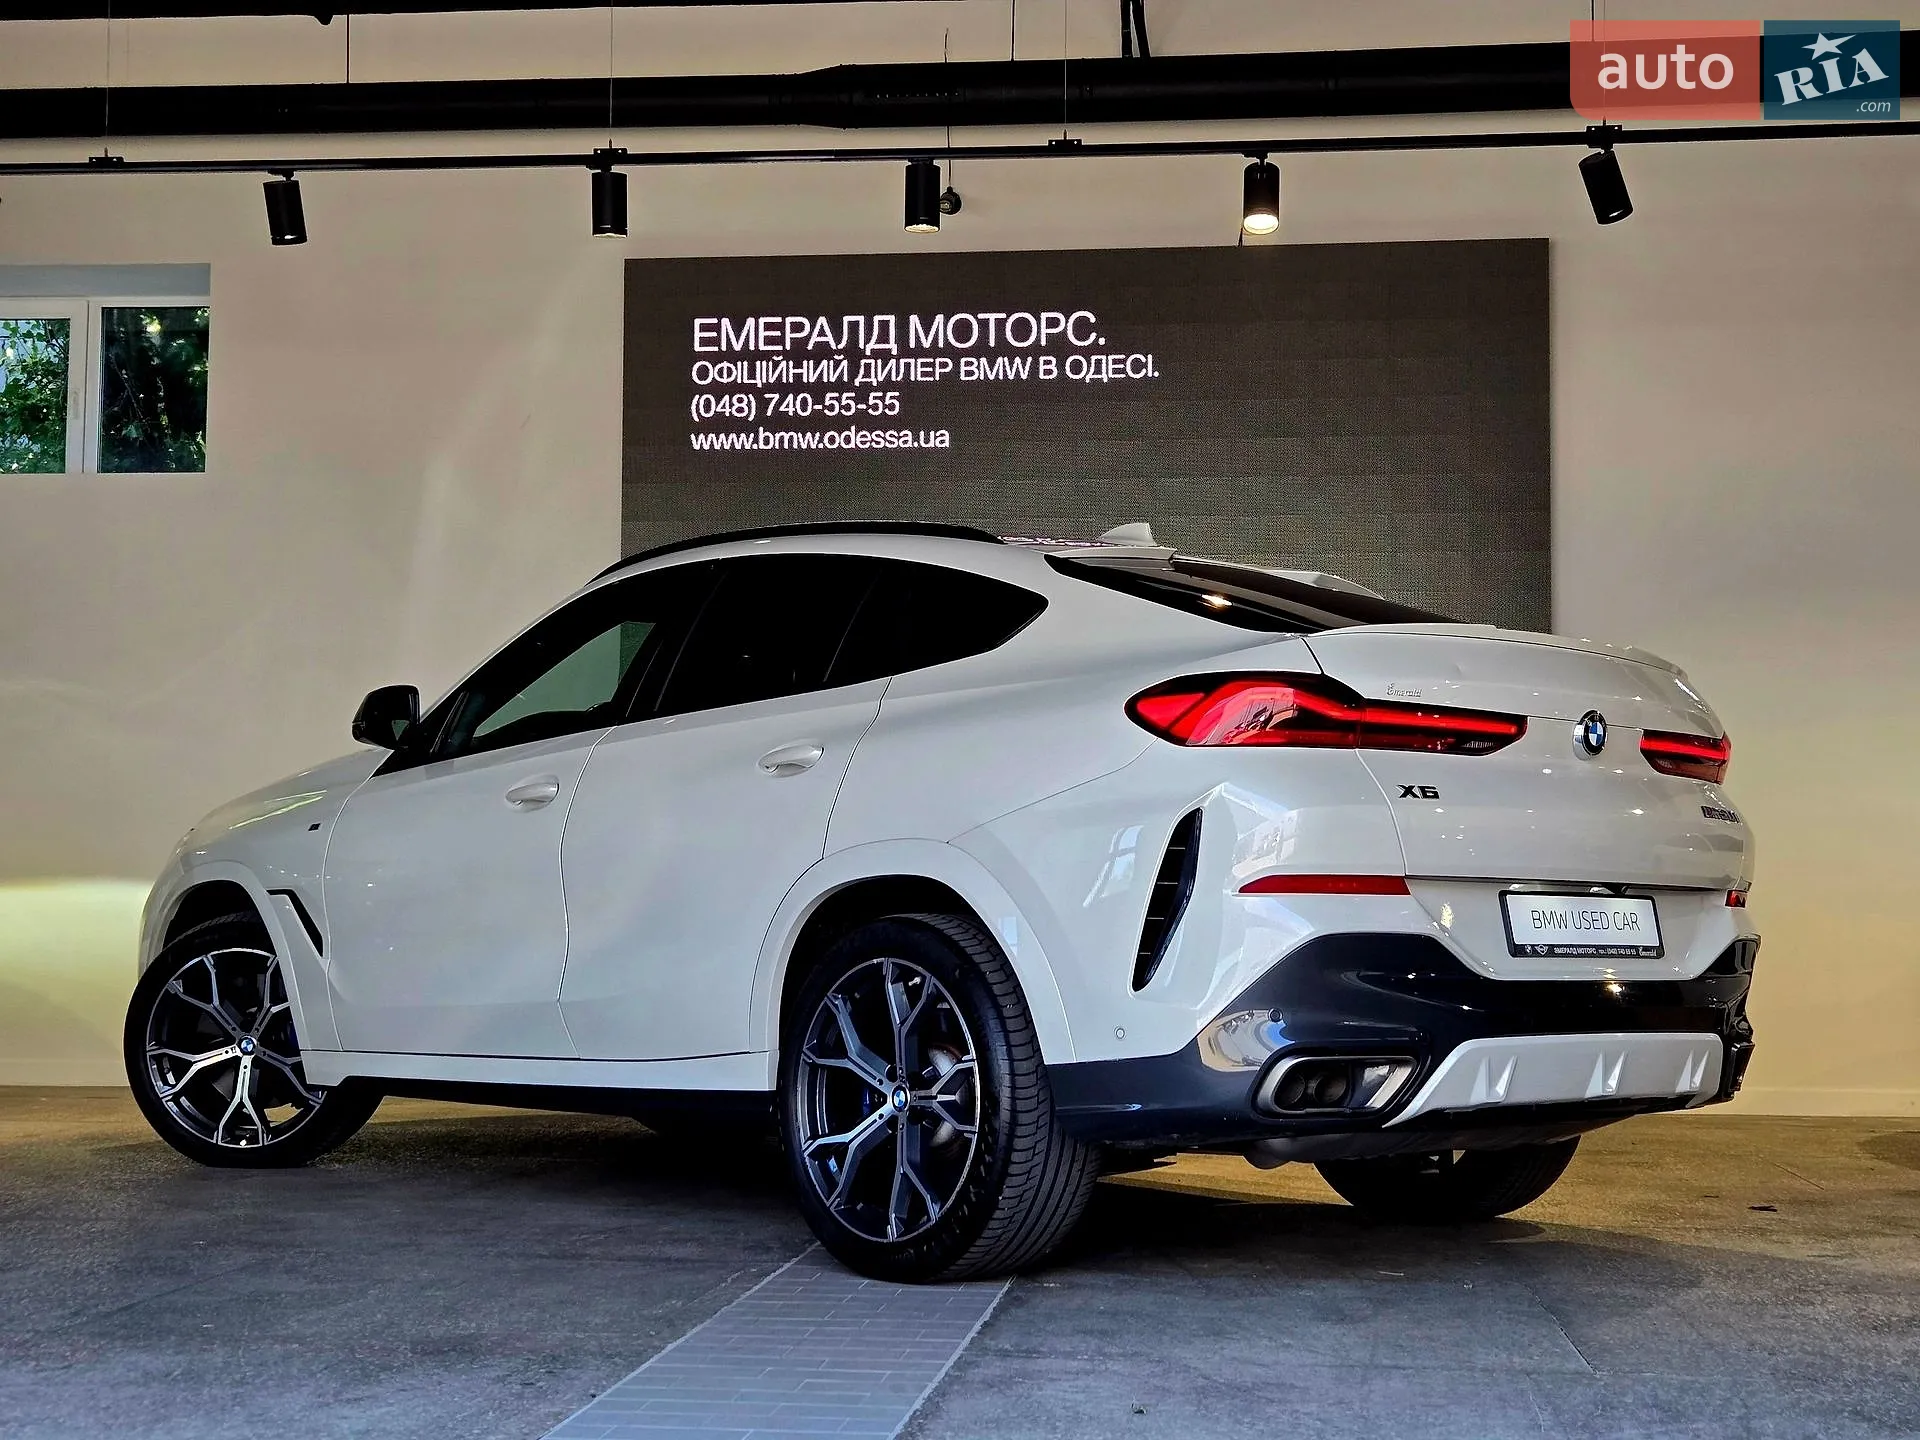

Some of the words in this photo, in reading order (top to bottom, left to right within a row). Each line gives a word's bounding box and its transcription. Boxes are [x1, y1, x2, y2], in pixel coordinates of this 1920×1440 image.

[692, 315, 897, 354] ЕМЕРАЛД
[908, 310, 1107, 350] МОТОРС.
[691, 354, 848, 387] ОФІЦІЙНИЙ
[854, 358, 953, 386] ДИЛЕР
[960, 356, 1032, 381] BMW
[1039, 357, 1057, 380] В
[1065, 354, 1160, 383] ОДЕСІ.
[690, 393, 757, 423] (048)
[763, 391, 901, 417] 740-55-55
[690, 427, 950, 451] www.bmw.odessa.ua
[1397, 784, 1440, 799] X6
[1531, 909, 1569, 930] BMW
[1572, 910, 1611, 930] USED
[1613, 911, 1640, 931] CAR
